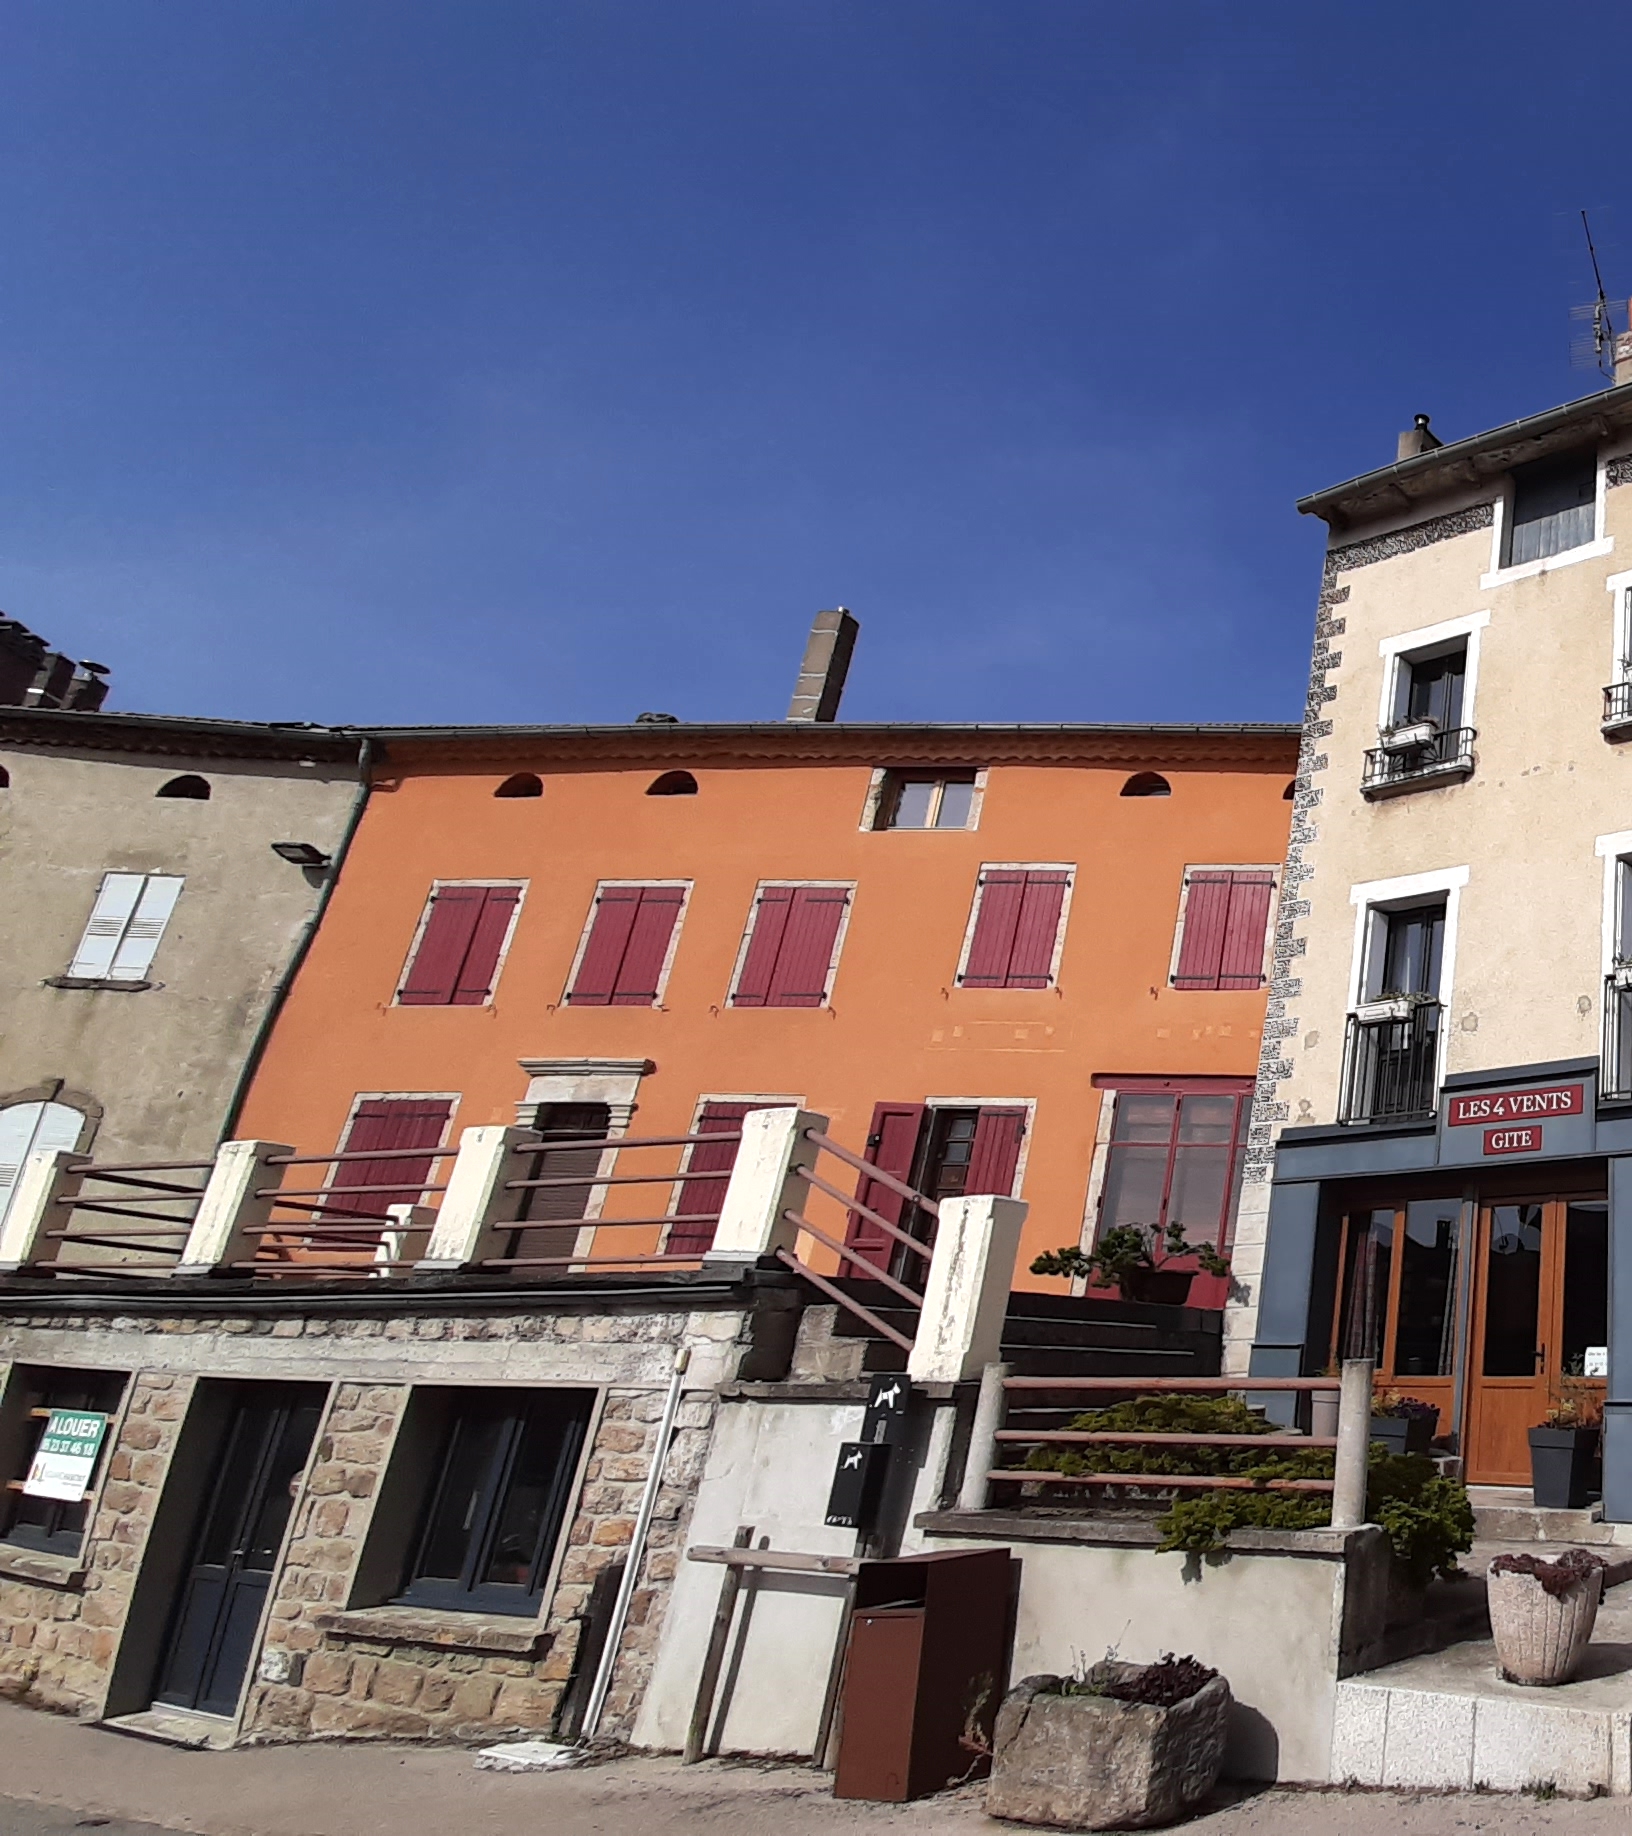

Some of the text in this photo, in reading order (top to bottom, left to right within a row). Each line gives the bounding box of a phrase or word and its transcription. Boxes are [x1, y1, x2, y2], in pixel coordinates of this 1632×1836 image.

[1458, 1090, 1572, 1119] LES 4 VENTS
[1491, 1130, 1532, 1149] GITE
[56, 1417, 101, 1438] LOUER
